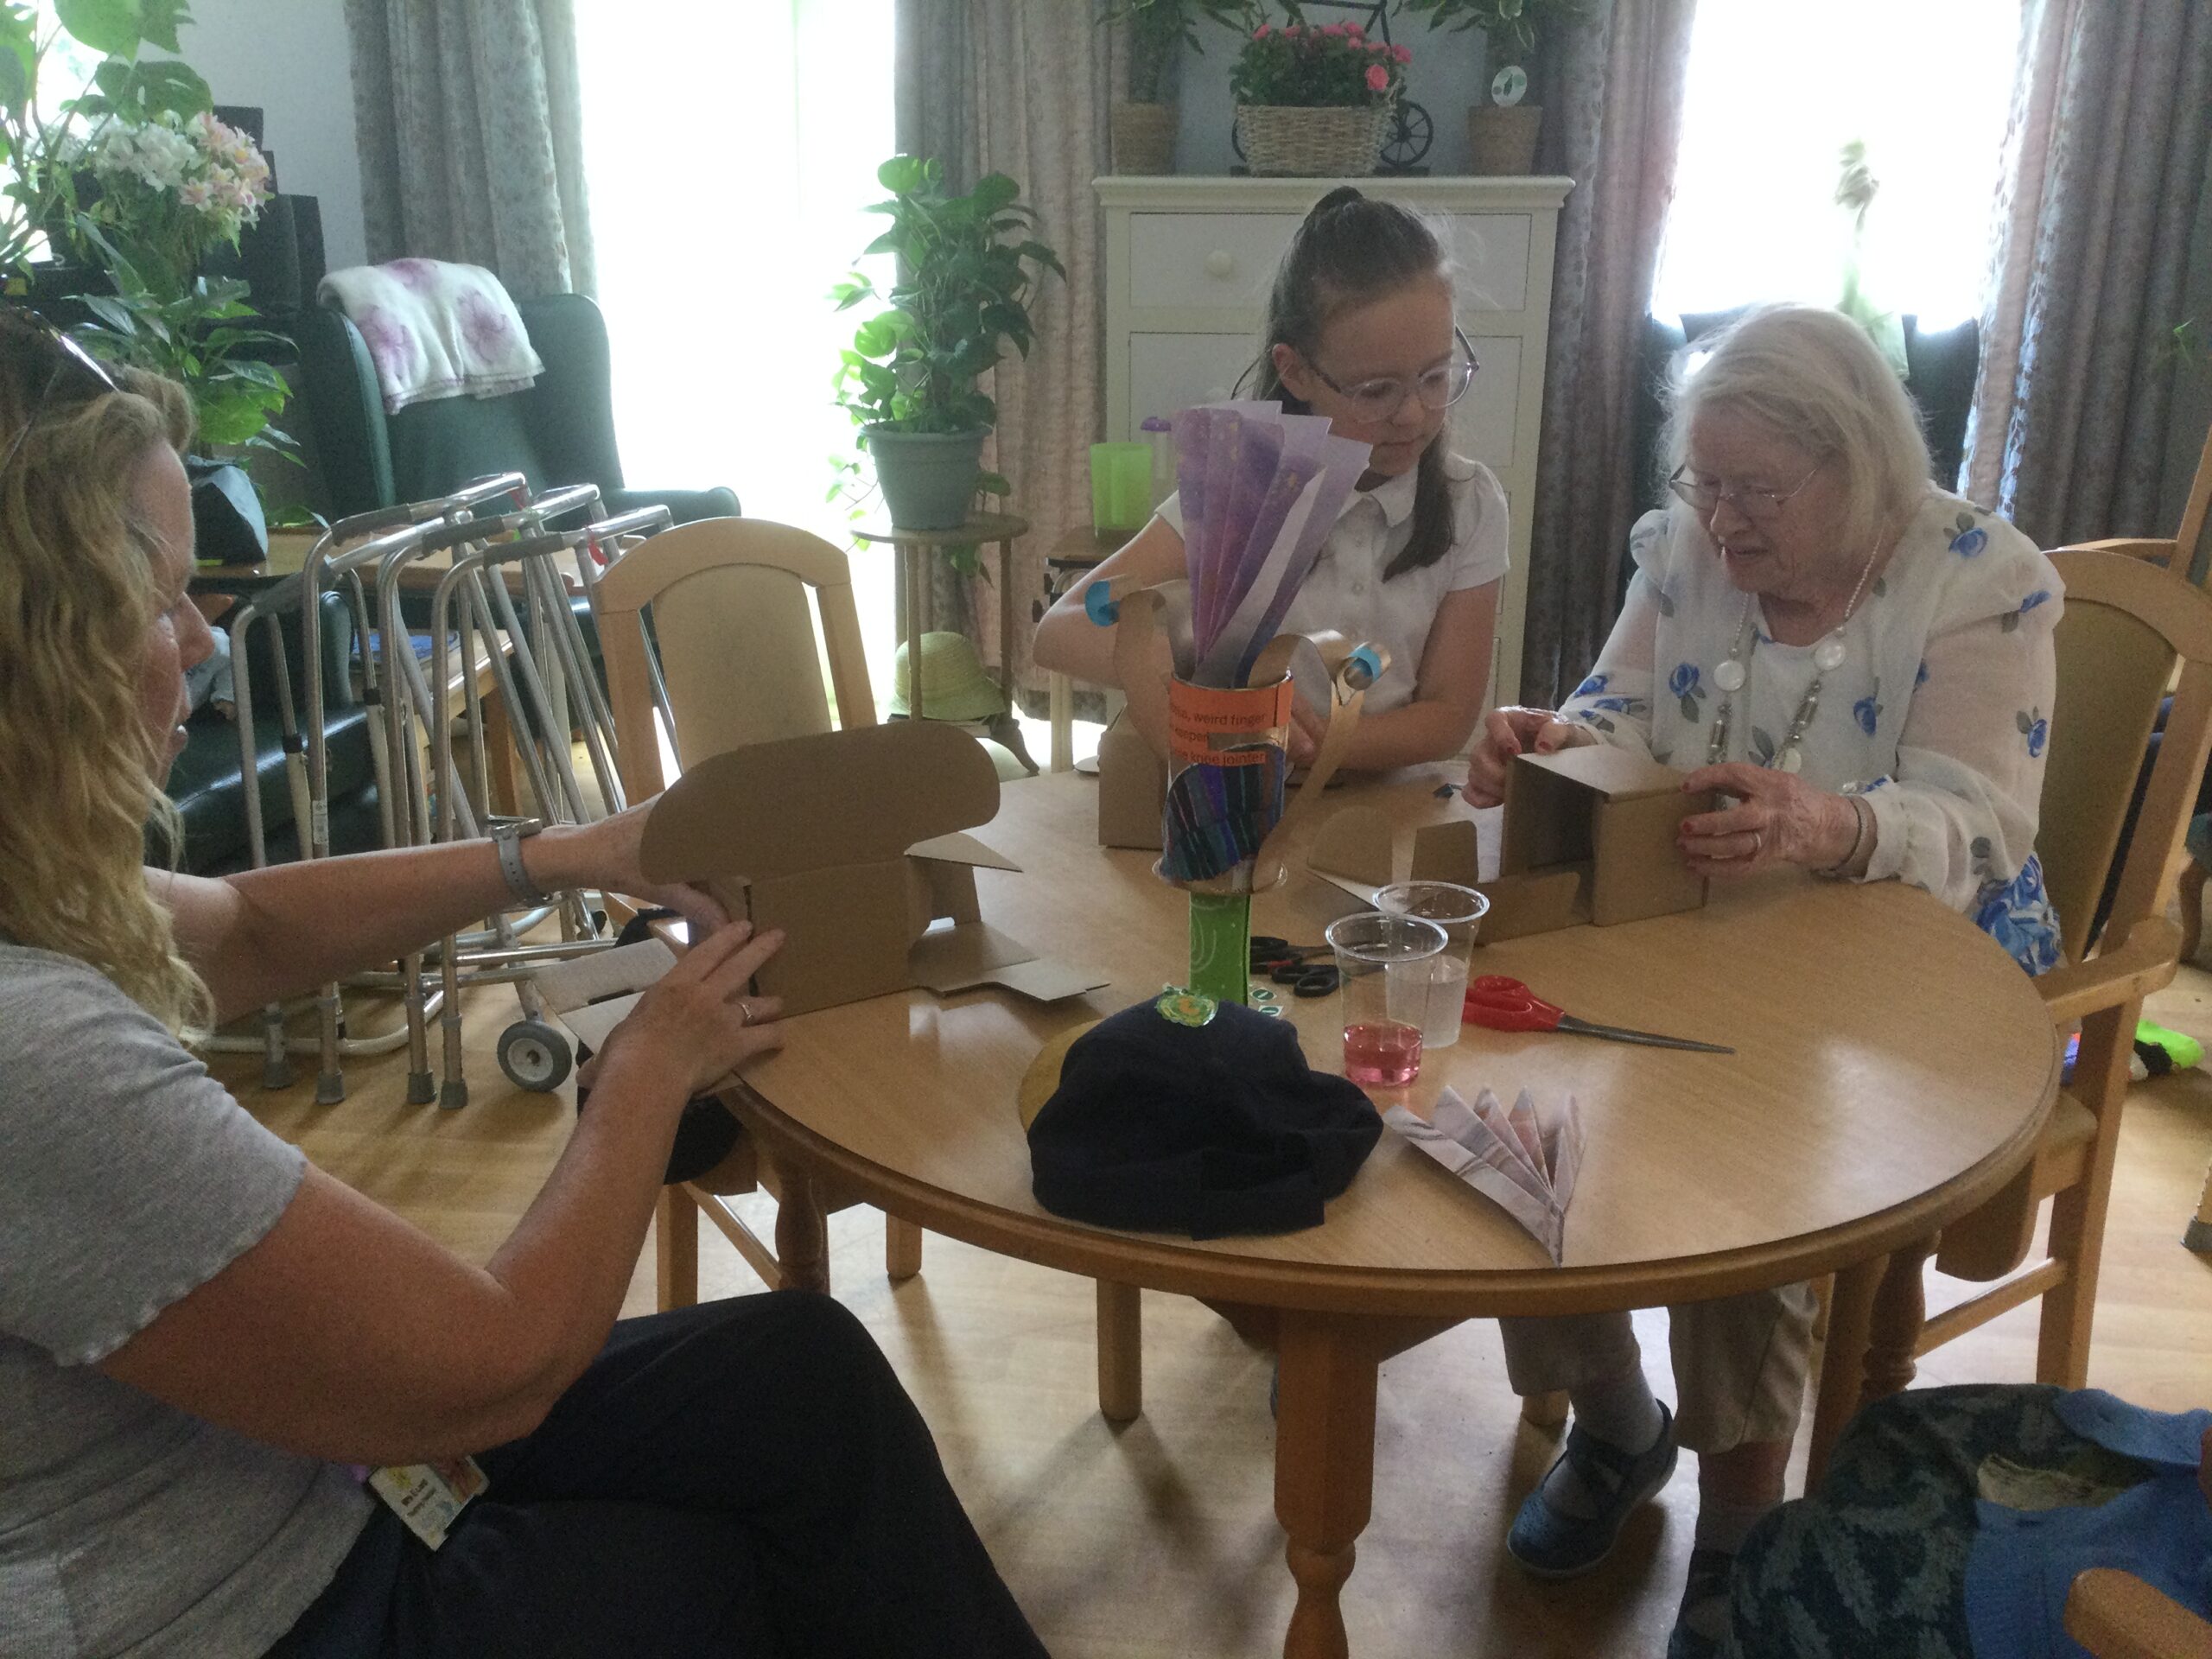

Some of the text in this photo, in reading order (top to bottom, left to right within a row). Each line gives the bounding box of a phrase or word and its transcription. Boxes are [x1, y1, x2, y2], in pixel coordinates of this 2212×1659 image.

[1194, 712, 1267, 728] weird finger
[1190, 751, 1220, 764] knee
